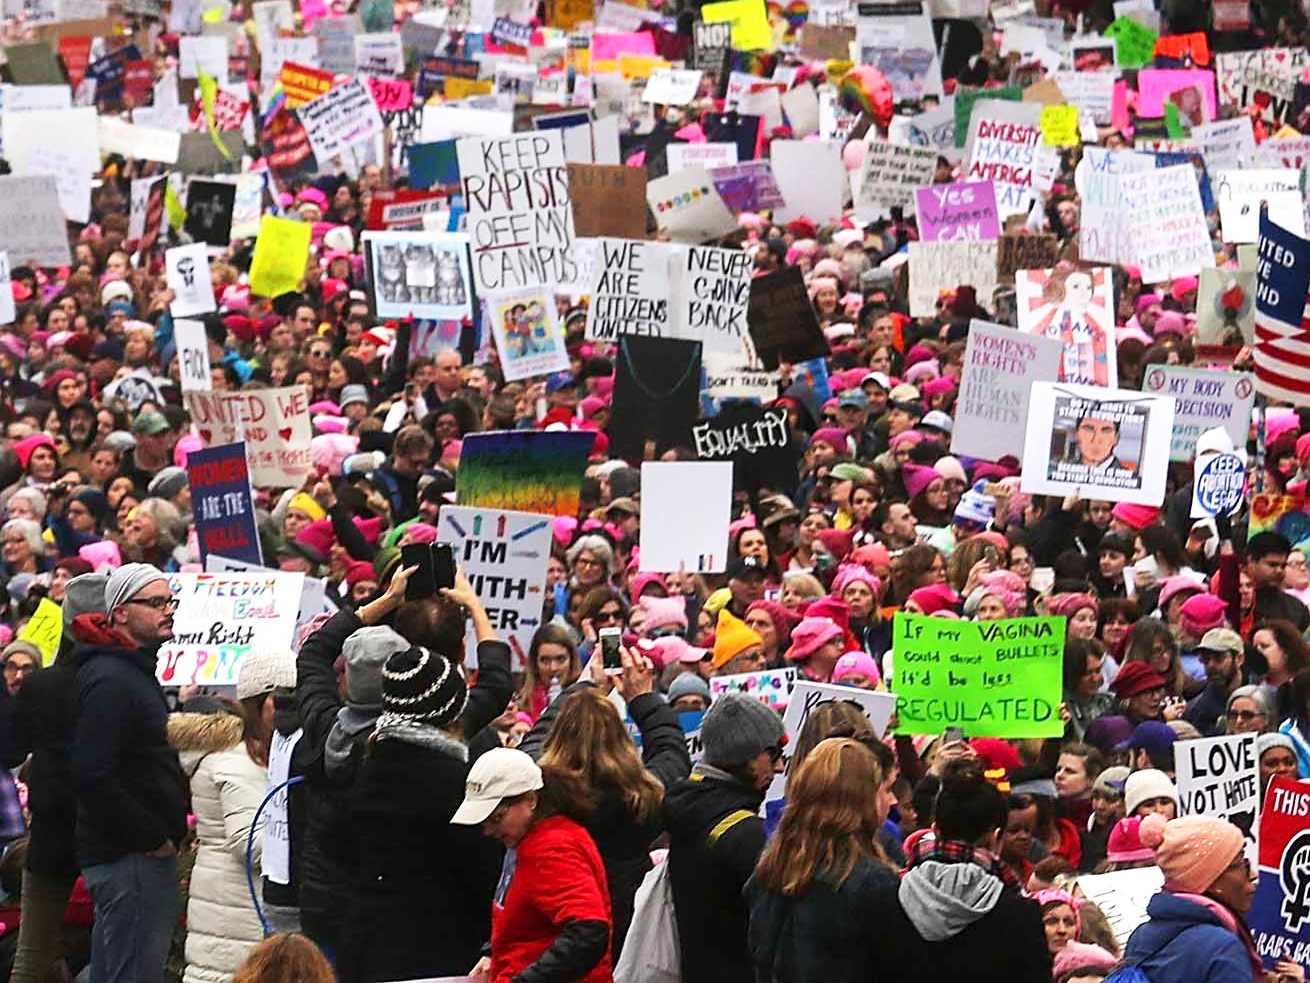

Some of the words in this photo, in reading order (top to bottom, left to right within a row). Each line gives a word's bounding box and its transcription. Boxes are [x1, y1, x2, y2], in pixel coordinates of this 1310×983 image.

[977, 120, 1043, 147] DIVERSITY
[480, 137, 551, 173] KEEP
[968, 161, 1035, 187] AMERICA
[463, 167, 570, 213] RAPISTS
[931, 185, 976, 210] Yes
[475, 213, 533, 248] OFF
[535, 209, 571, 253] MY
[477, 245, 579, 290] CAMPUS
[601, 240, 646, 273] WE
[687, 246, 753, 280] NEVER
[595, 270, 642, 296] ARE
[693, 274, 751, 308] GOING
[594, 296, 668, 324] CITIZENS
[687, 300, 743, 337] BACK
[592, 317, 661, 339] UNITED
[972, 331, 1037, 361] WOMEN'S
[970, 349, 1027, 376] RIGHTS
[1170, 377, 1189, 395] MY
[1193, 379, 1226, 397] BODY
[277, 391, 307, 421] WE
[1174, 399, 1235, 421] DECISION
[692, 408, 789, 458] EQUALITY
[462, 539, 508, 565] I'M
[484, 606, 521, 631] ER
[977, 622, 1054, 643] VAGINA
[995, 642, 1060, 663] BULLETS
[947, 670, 969, 687] be
[895, 697, 1053, 723] REGULATED
[1189, 737, 1256, 780] LOVE
[1178, 783, 1220, 819] NOT
[1222, 774, 1257, 814] HATE
[1272, 787, 1310, 817] THIS
[1252, 932, 1292, 967] RABS
